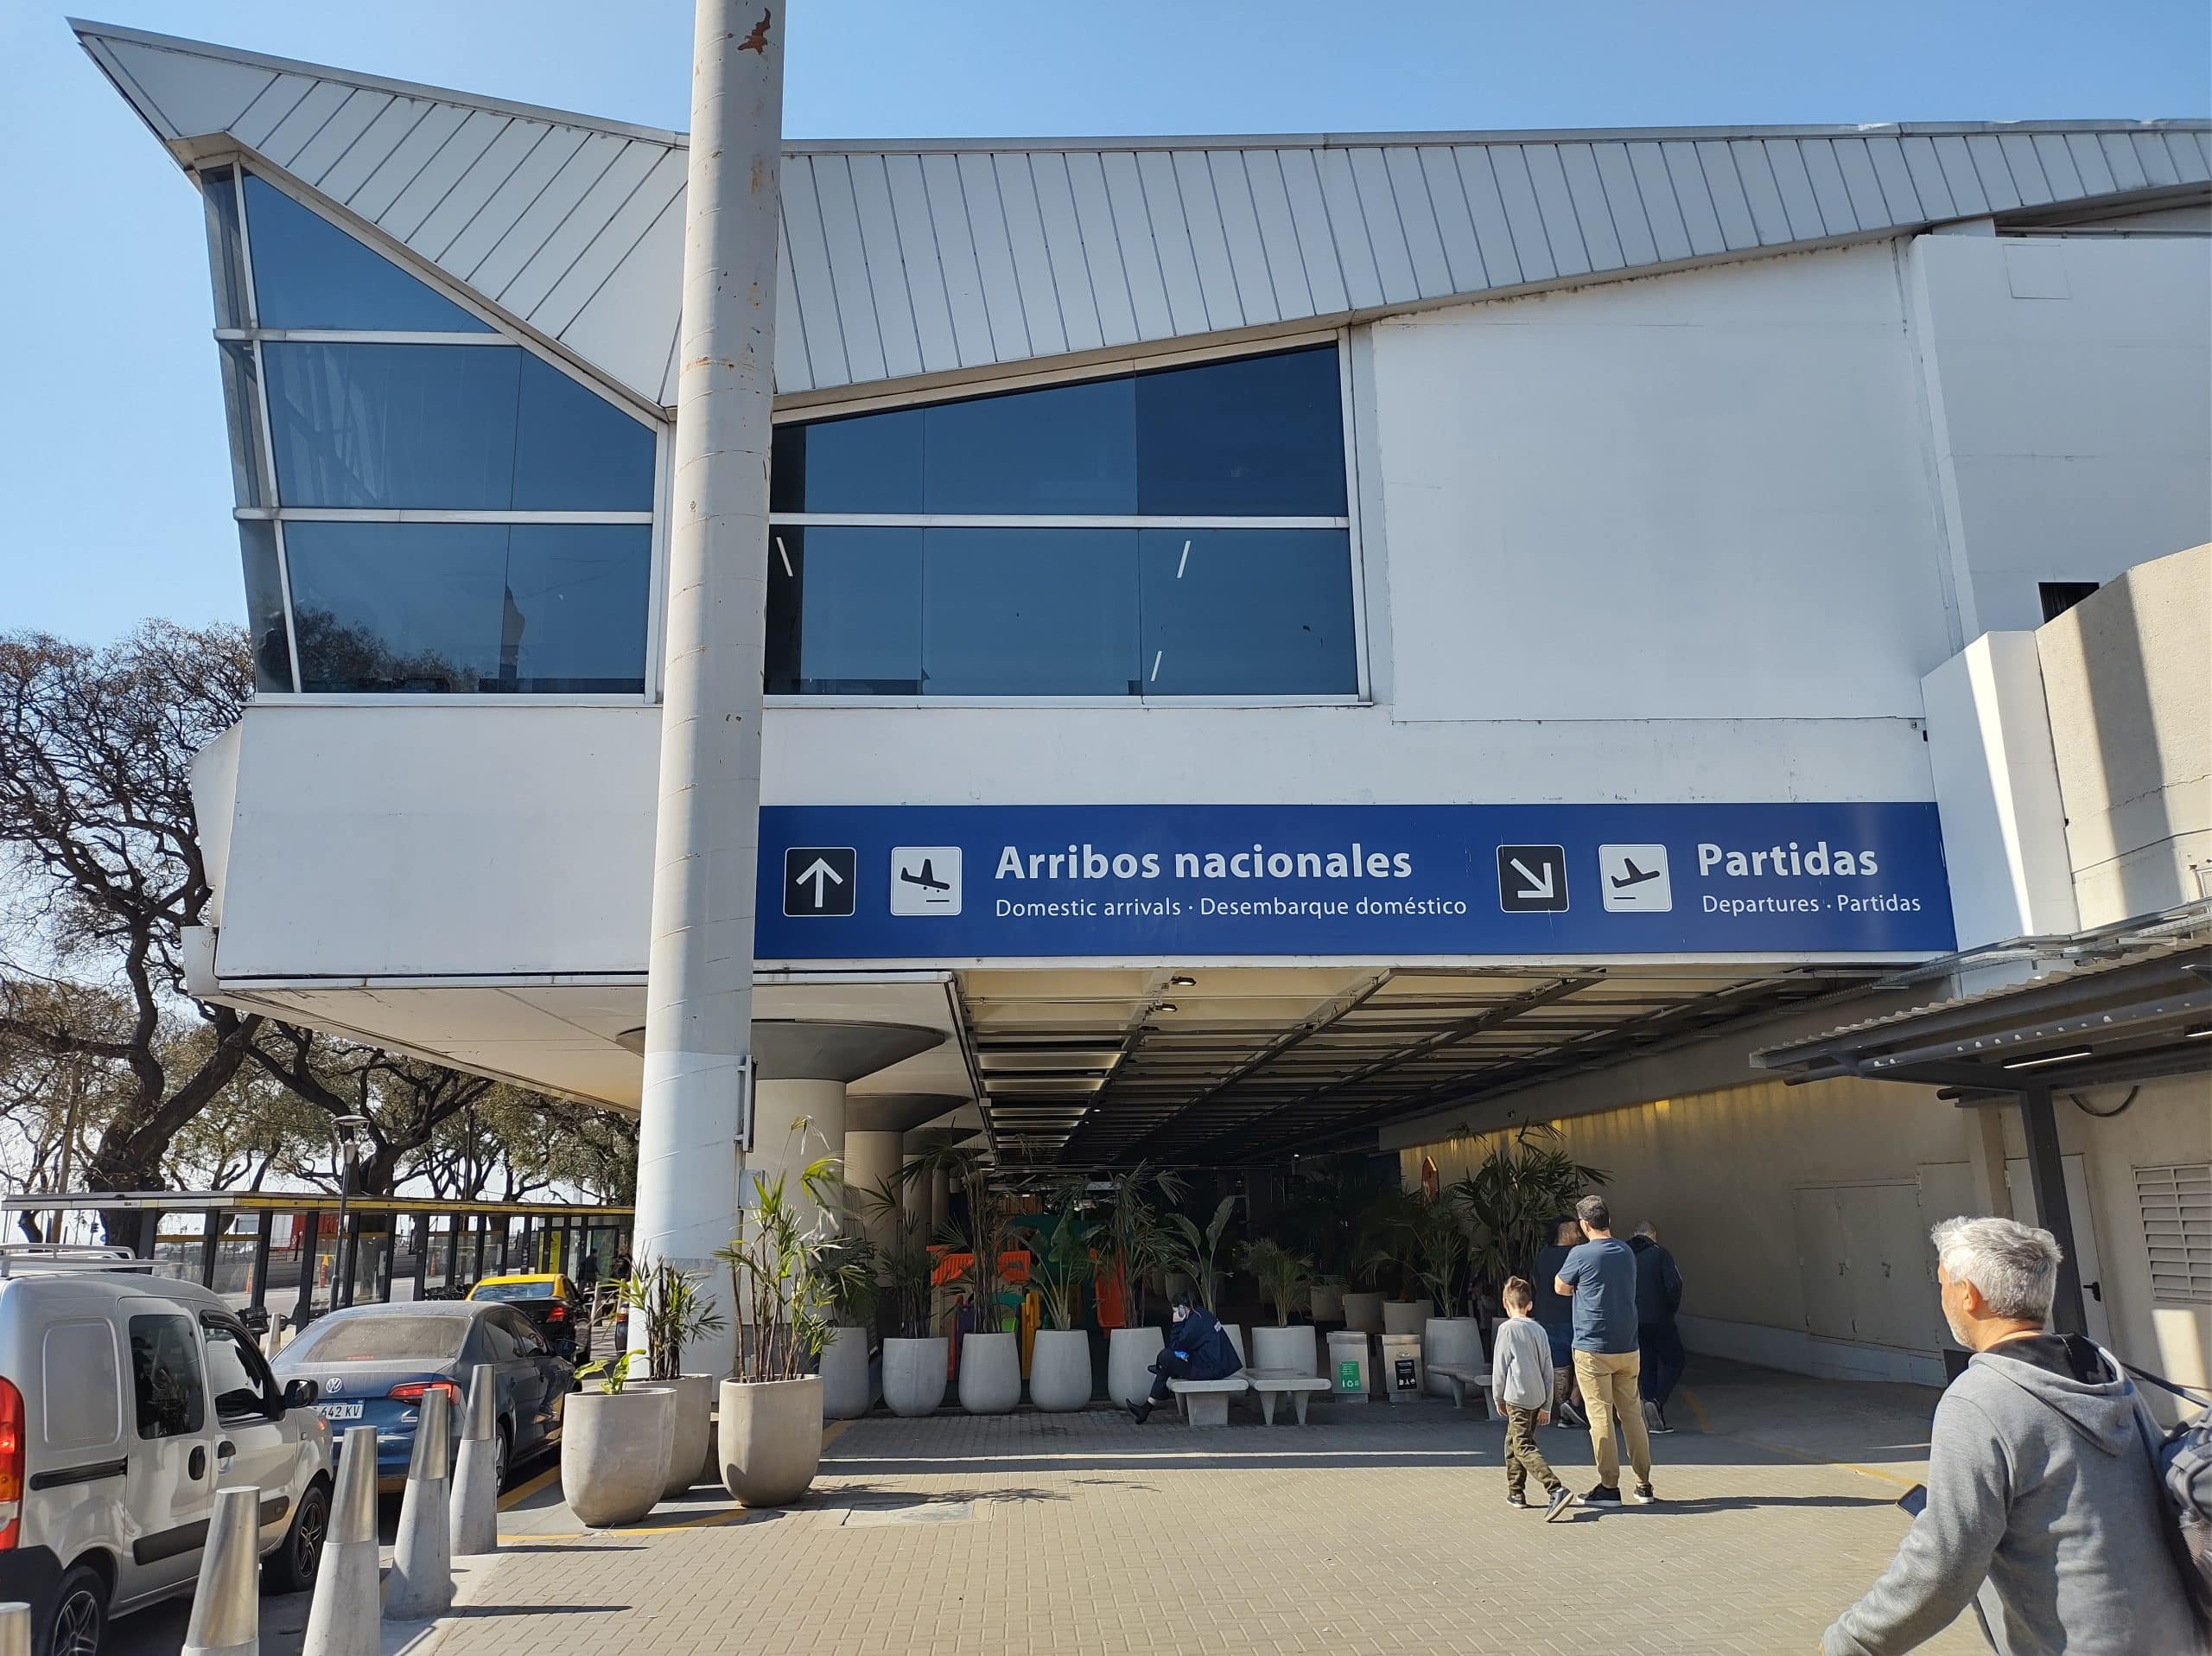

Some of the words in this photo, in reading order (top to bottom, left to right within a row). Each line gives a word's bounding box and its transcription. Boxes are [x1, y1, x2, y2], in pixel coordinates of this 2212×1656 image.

[995, 844, 1160, 879] Arribos
[1175, 843, 1412, 878] nacionales
[1697, 841, 1878, 876] Partidas
[996, 898, 1097, 917] Domestic
[1103, 897, 1181, 916] arrivals
[1200, 896, 1349, 920] Desembarque
[1356, 896, 1467, 914] doméstico
[1702, 895, 1820, 917] Departures
[1837, 893, 1921, 912] Partidas
[346, 1405, 359, 1417] KV
